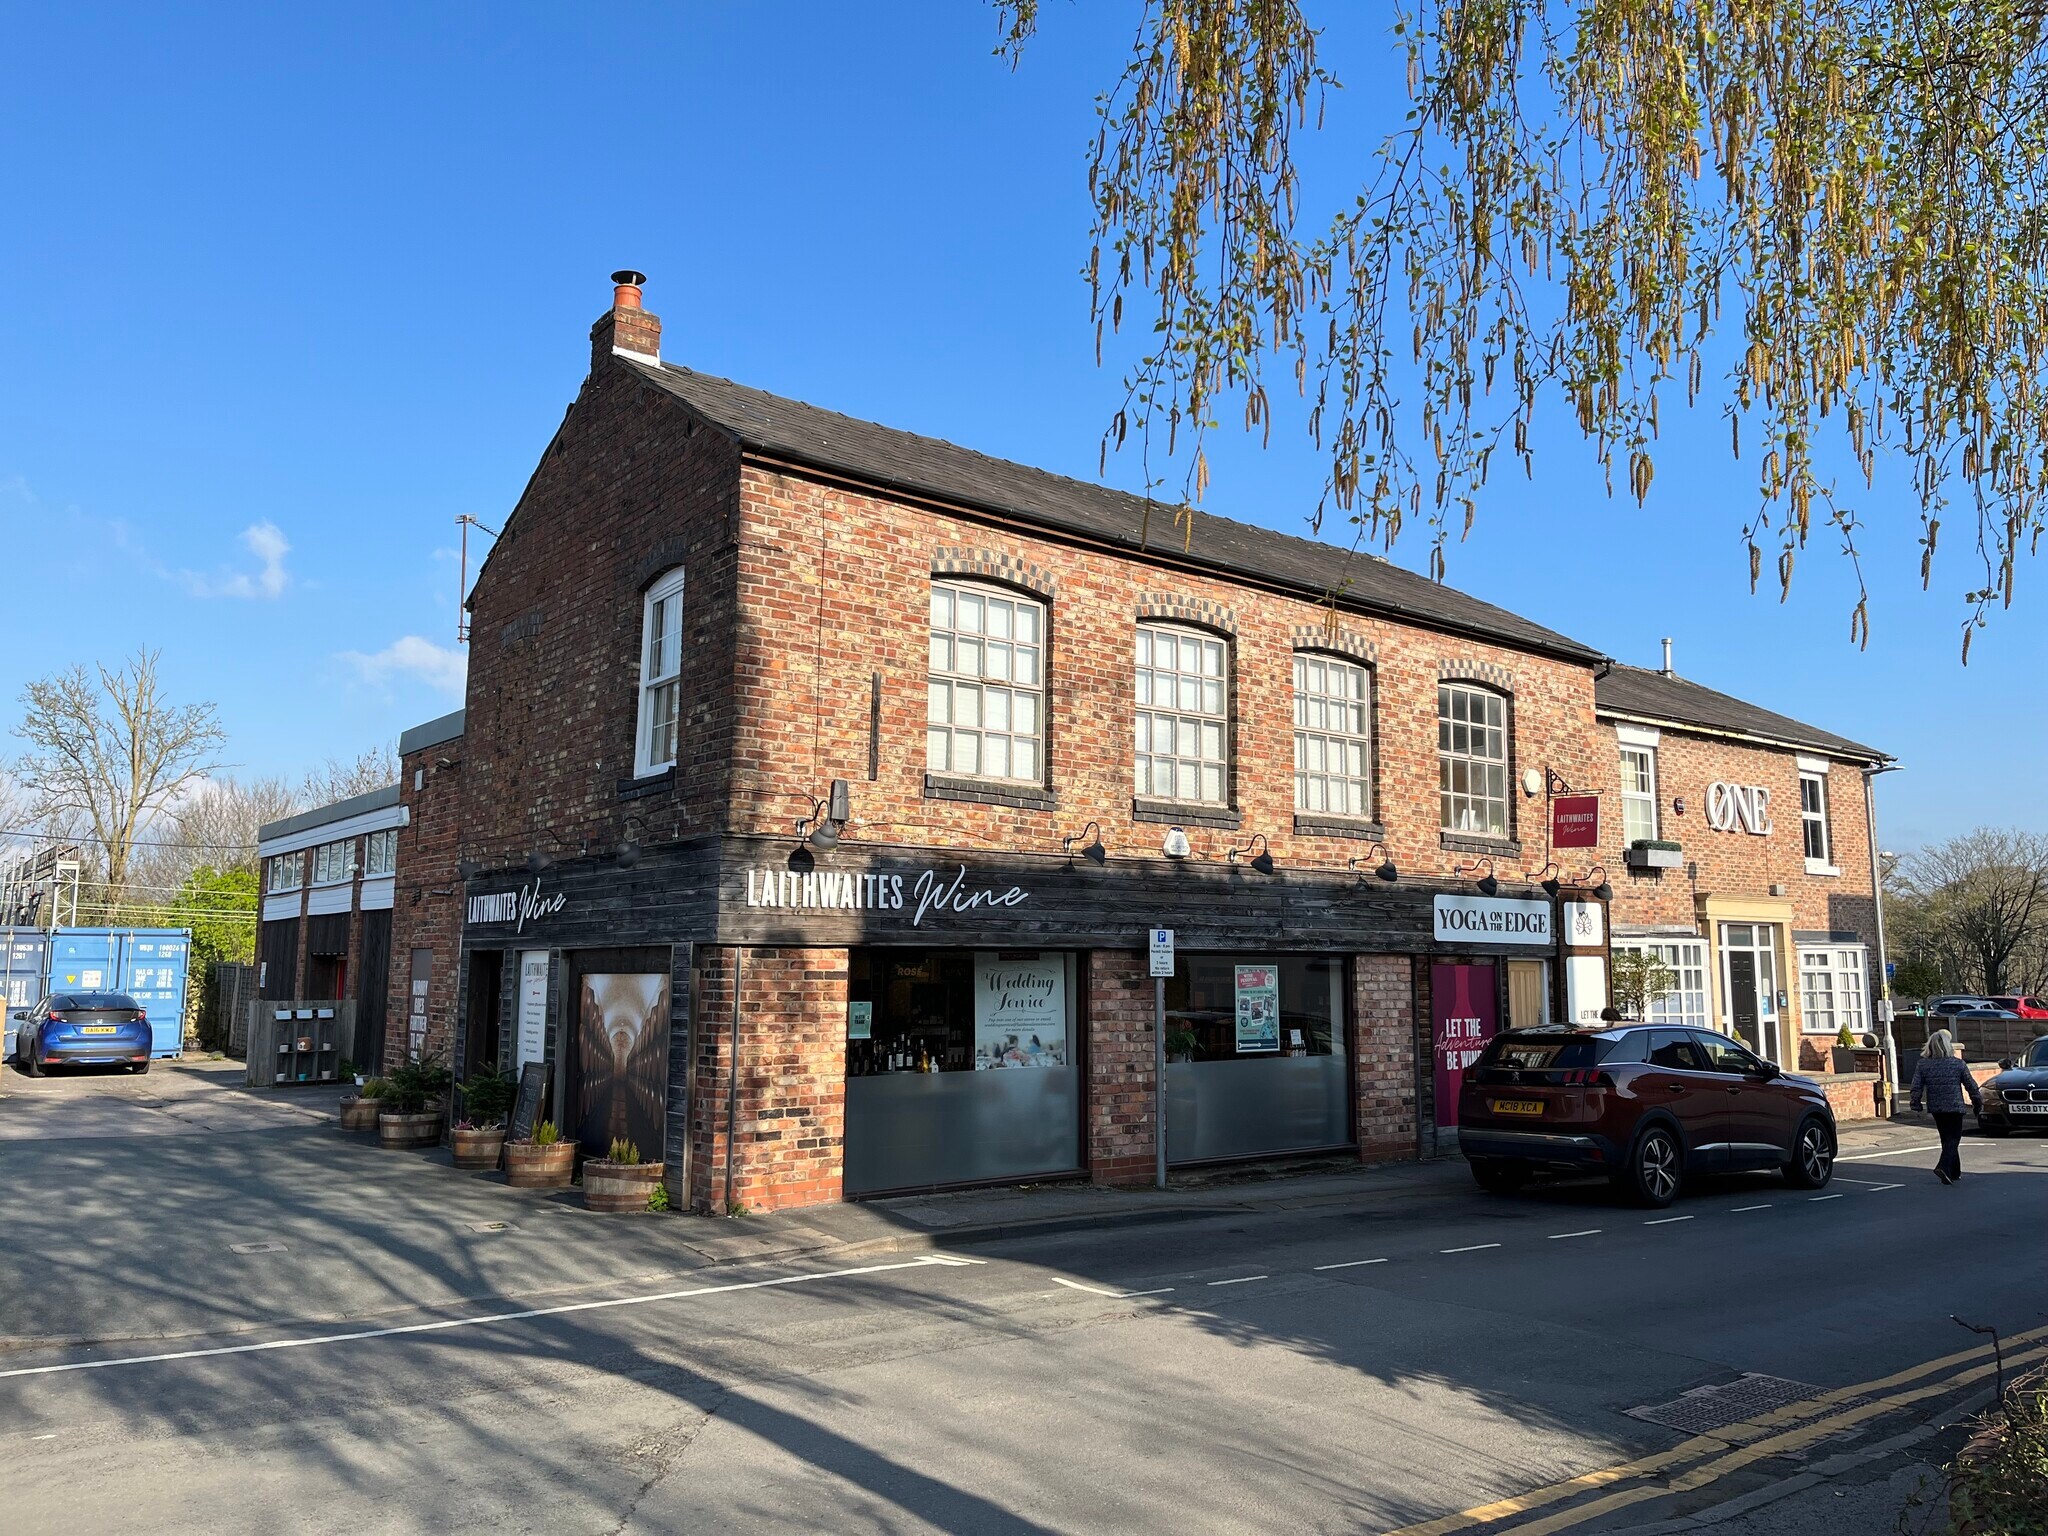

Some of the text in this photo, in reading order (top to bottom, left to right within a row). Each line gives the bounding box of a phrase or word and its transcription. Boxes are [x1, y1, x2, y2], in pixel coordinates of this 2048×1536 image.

[1556, 813, 1594, 823] LAITHWAITES
[1562, 823, 1587, 836] Wine
[467, 877, 567, 933] LAITHWAITES Wine
[747, 864, 1029, 926] LAITHWAITES Wine
[1438, 908, 1547, 934] YOGA ON THE EDGE
[985, 972, 1054, 996] Wedding
[994, 992, 1045, 1011] Service
[1580, 1010, 1599, 1020] LET THE
[1445, 1018, 1482, 1038] LET THE
[1434, 1031, 1493, 1059] Adventure
[1446, 1051, 1459, 1071] BE
[1499, 1101, 1538, 1113] MC18 XCA
